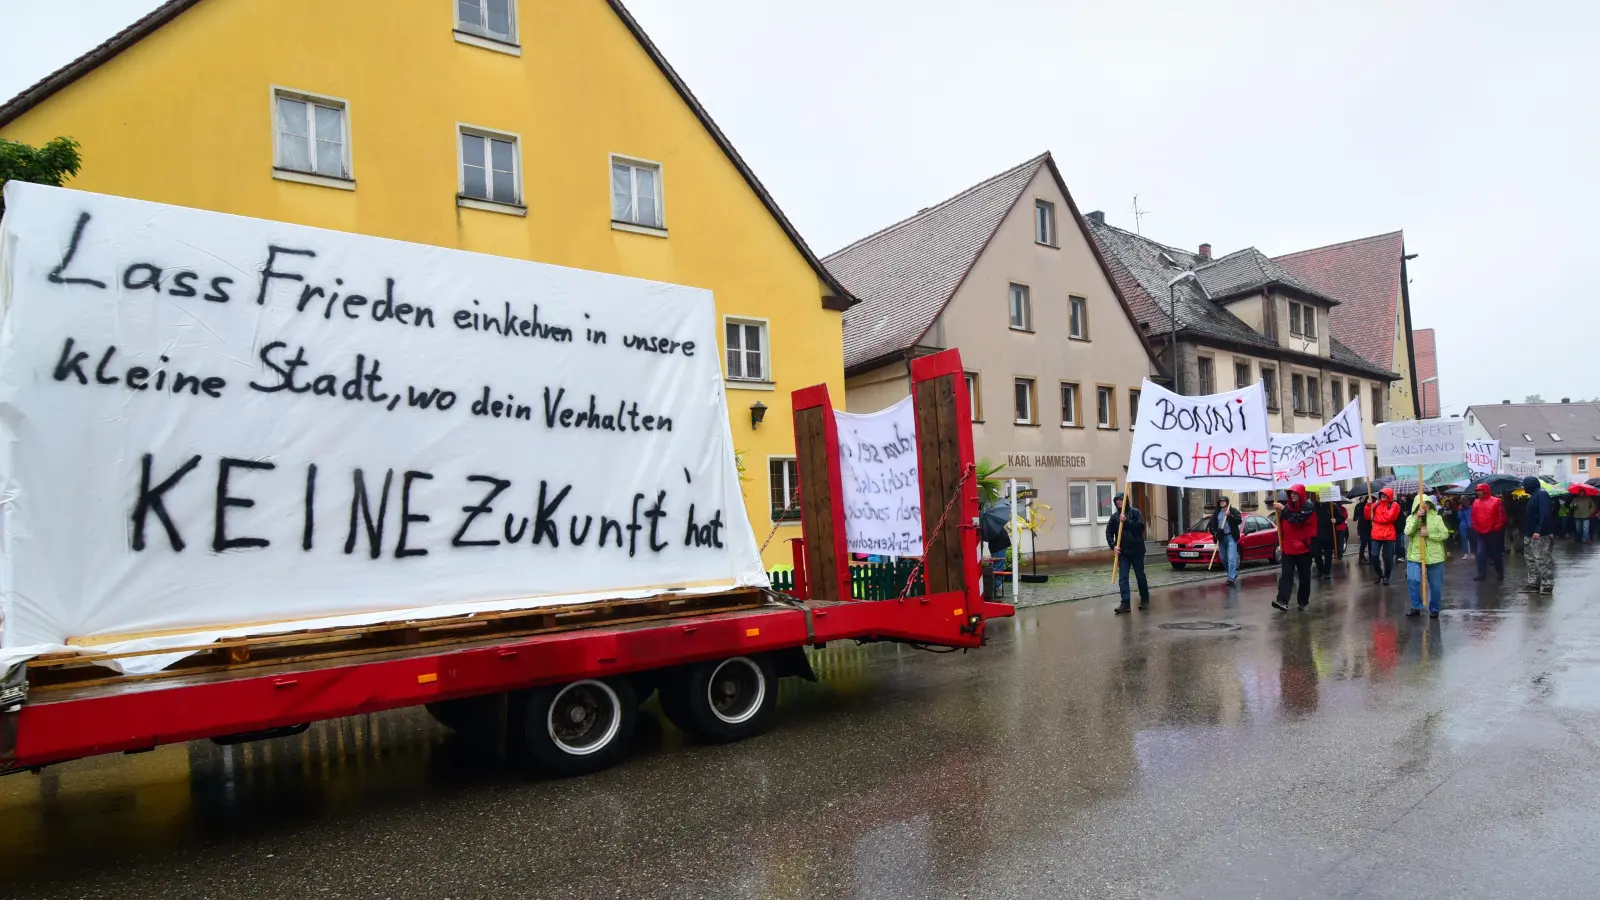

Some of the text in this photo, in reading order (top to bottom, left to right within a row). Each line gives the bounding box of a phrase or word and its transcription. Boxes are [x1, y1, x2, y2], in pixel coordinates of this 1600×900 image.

[48, 211, 696, 357] Lass Frieden einkehren in unsere
[407, 385, 457, 411] wo
[471, 386, 531, 421] dein
[544, 386, 673, 432] Verhalten
[1389, 424, 1455, 440] RESPEKT
[1391, 442, 1455, 456] ANSTAND
[1008, 455, 1031, 467] KARL
[1192, 442, 1273, 476] HOME
[131, 452, 433, 560] KEINE
[684, 503, 724, 549] hat
